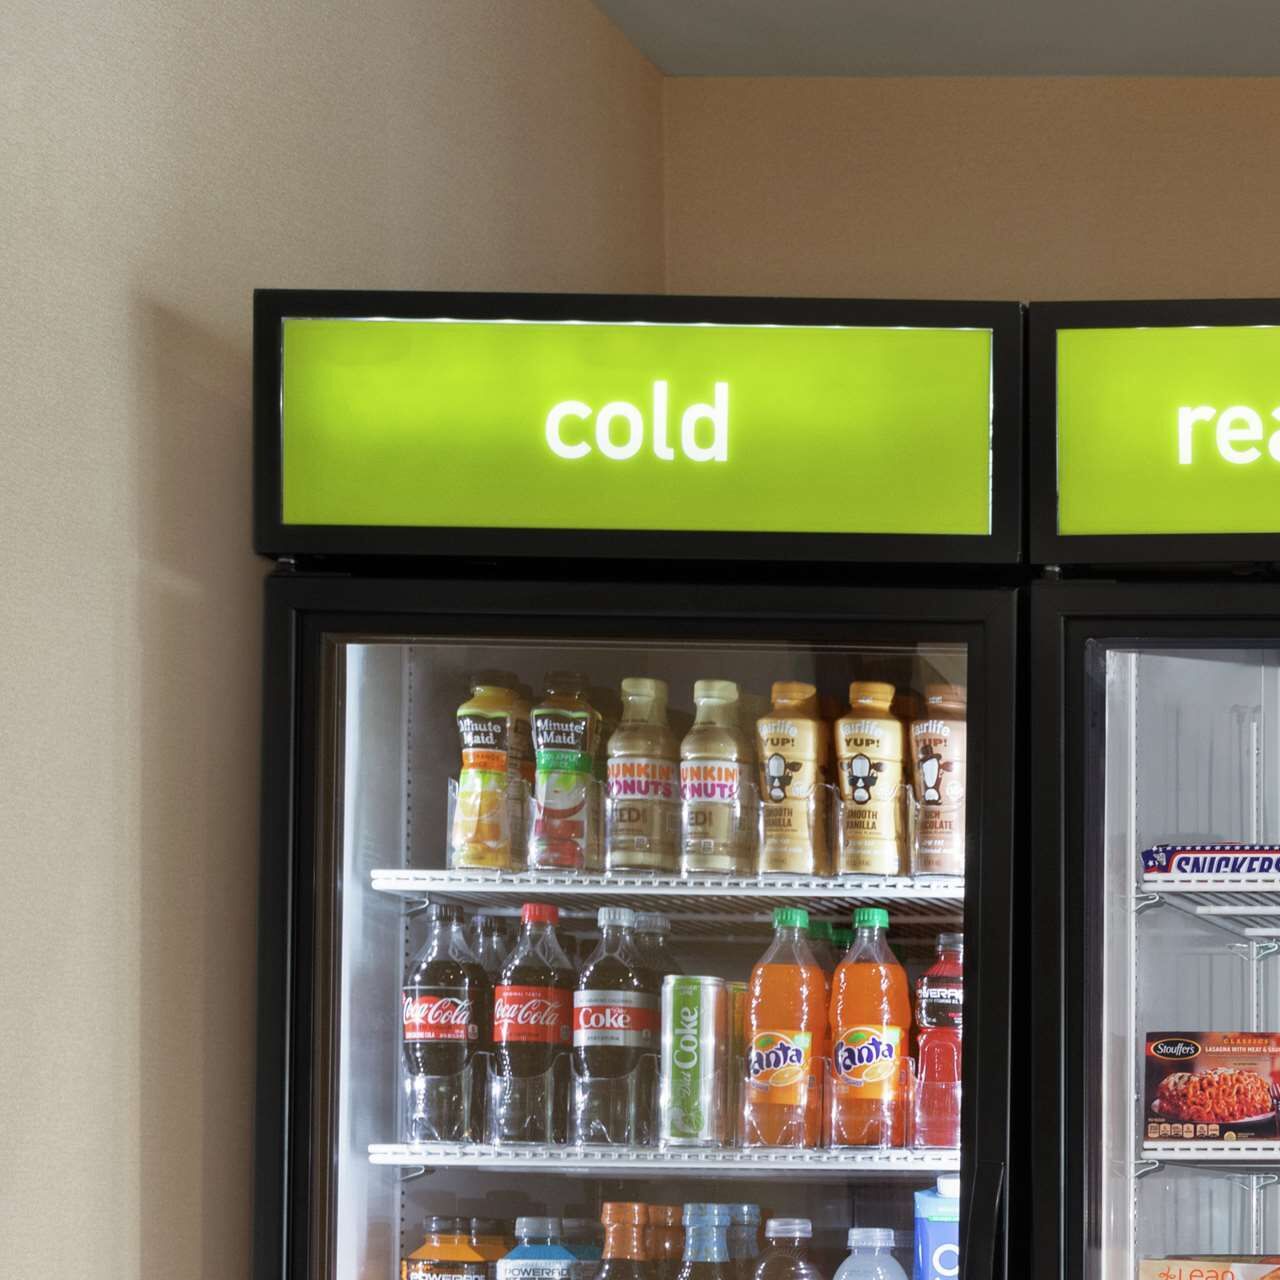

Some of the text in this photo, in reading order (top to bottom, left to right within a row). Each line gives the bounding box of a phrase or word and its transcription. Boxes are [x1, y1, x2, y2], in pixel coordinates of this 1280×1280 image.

[545, 381, 729, 462] cold
[459, 718, 501, 732] Minute
[538, 719, 582, 734] Minute
[463, 732, 496, 745] Maid
[543, 731, 576, 744] Maid
[845, 738, 880, 747] YUP!
[579, 1008, 630, 1028] Coke
[673, 1007, 699, 1070] Coke
[1157, 1043, 1194, 1057] Stouffer's
